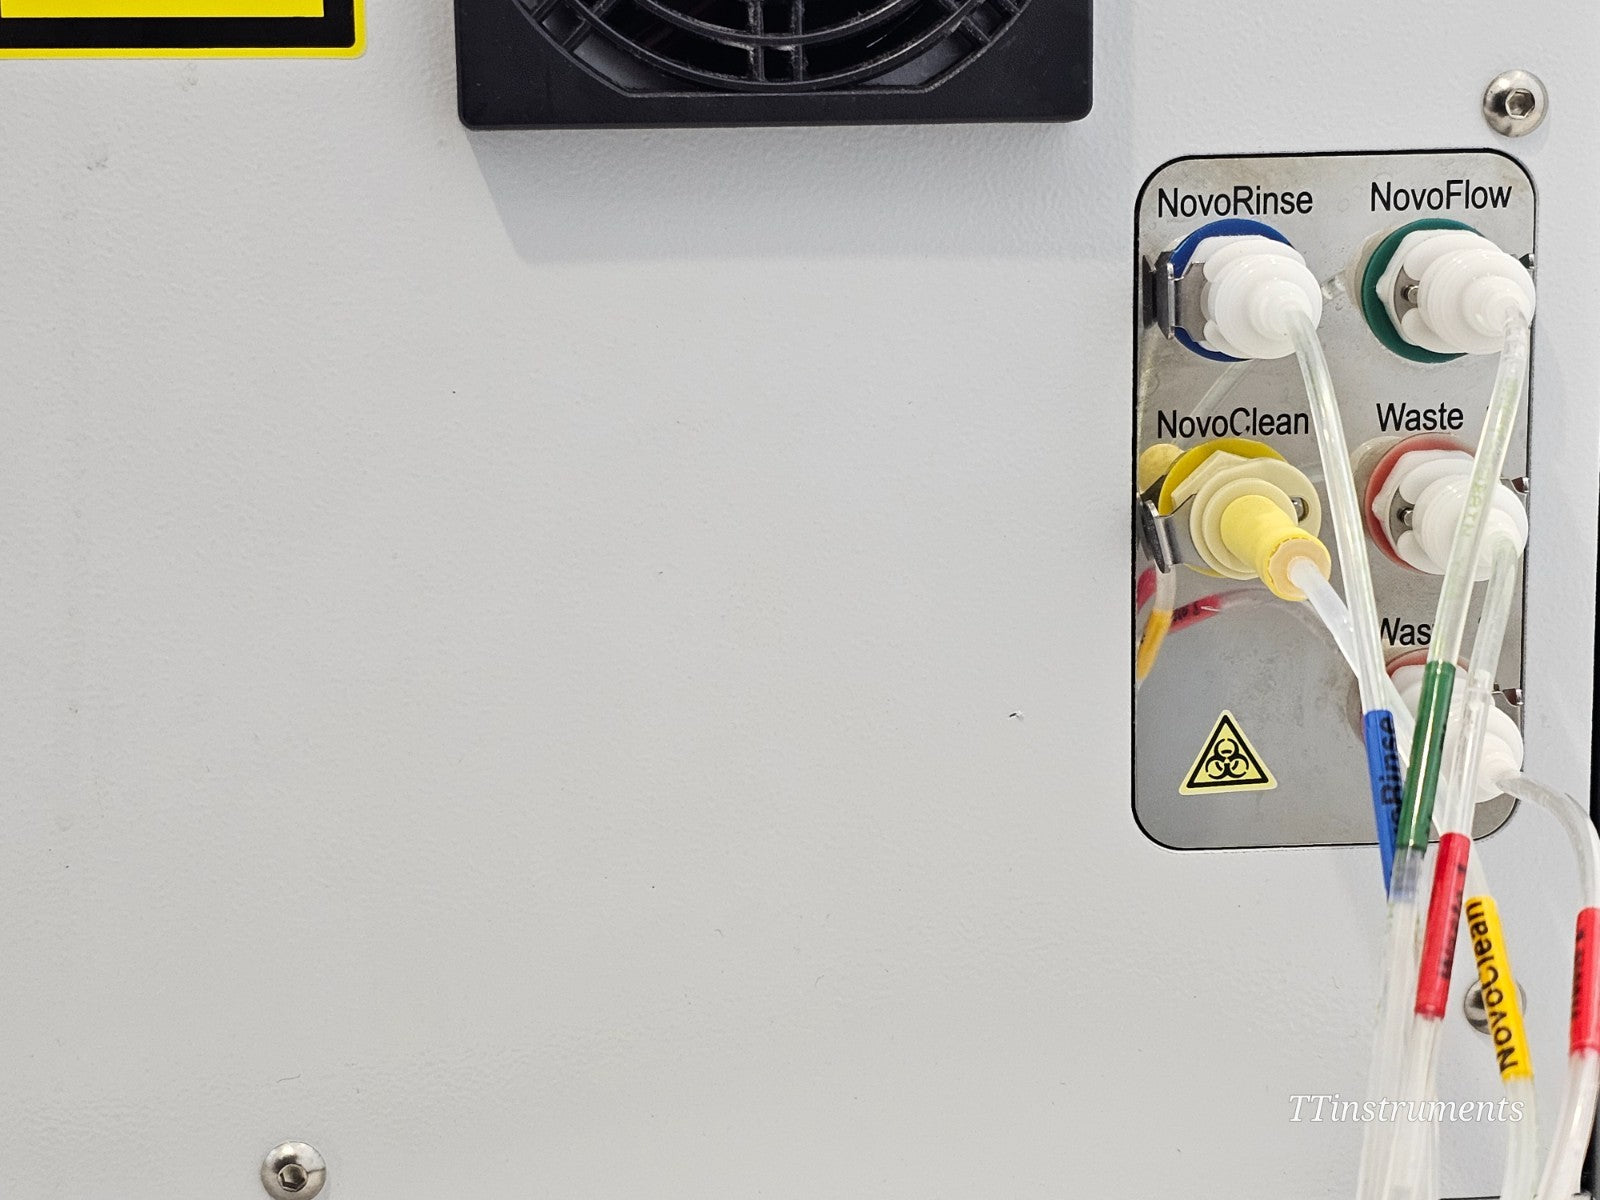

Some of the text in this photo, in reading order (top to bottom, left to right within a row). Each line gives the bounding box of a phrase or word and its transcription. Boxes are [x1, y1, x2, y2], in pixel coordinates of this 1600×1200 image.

[1157, 185, 1313, 218] NovoRinse
[1370, 180, 1513, 212] NovoFlow
[1157, 407, 1310, 438] NovoClean
[1376, 402, 1464, 432] Waste
[1380, 617, 1434, 646] Was
[1465, 900, 1518, 1073] NovoClean
